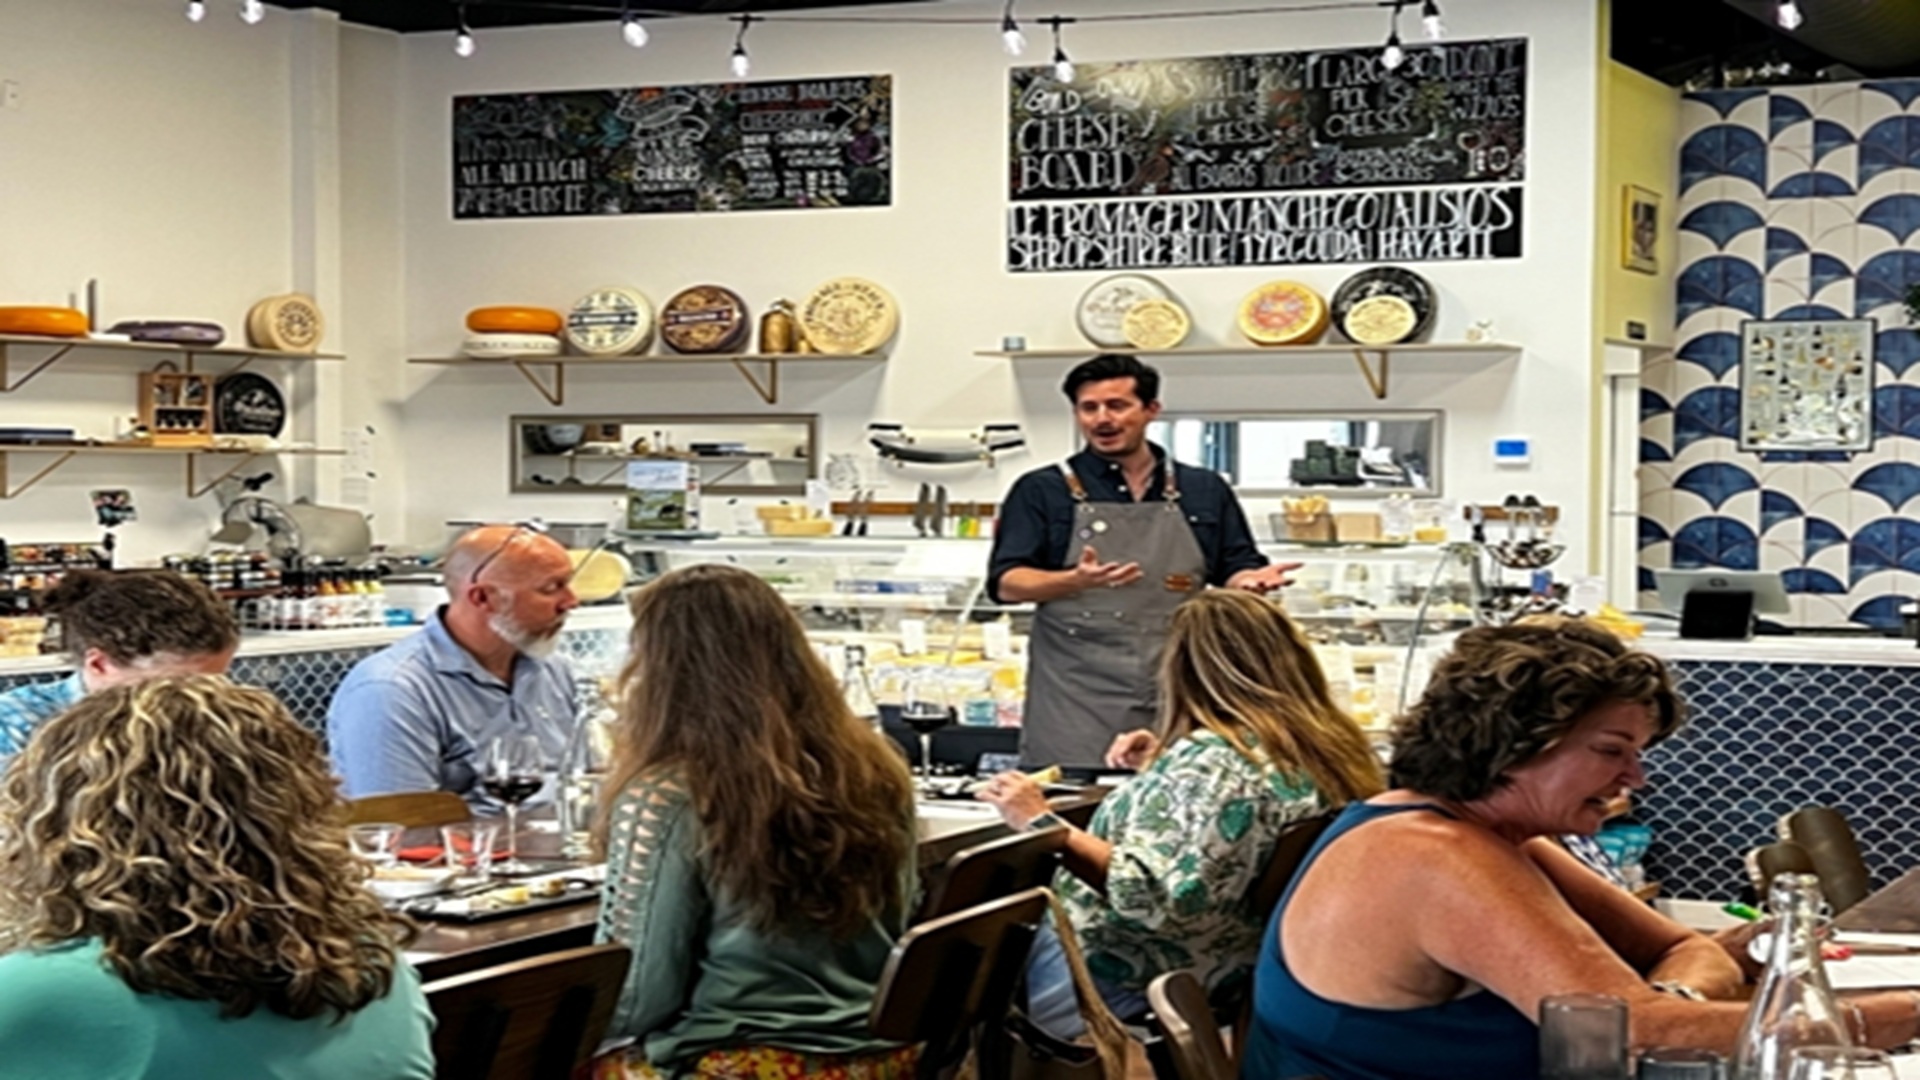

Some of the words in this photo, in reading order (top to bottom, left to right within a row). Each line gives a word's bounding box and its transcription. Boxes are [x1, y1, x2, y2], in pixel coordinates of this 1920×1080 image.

[1325, 106, 1412, 138] CHEESES
[1046, 199, 1200, 238] FROMAGER
[1212, 191, 1380, 235] MANCHEGO
[1378, 229, 1495, 260] HAVARTI
